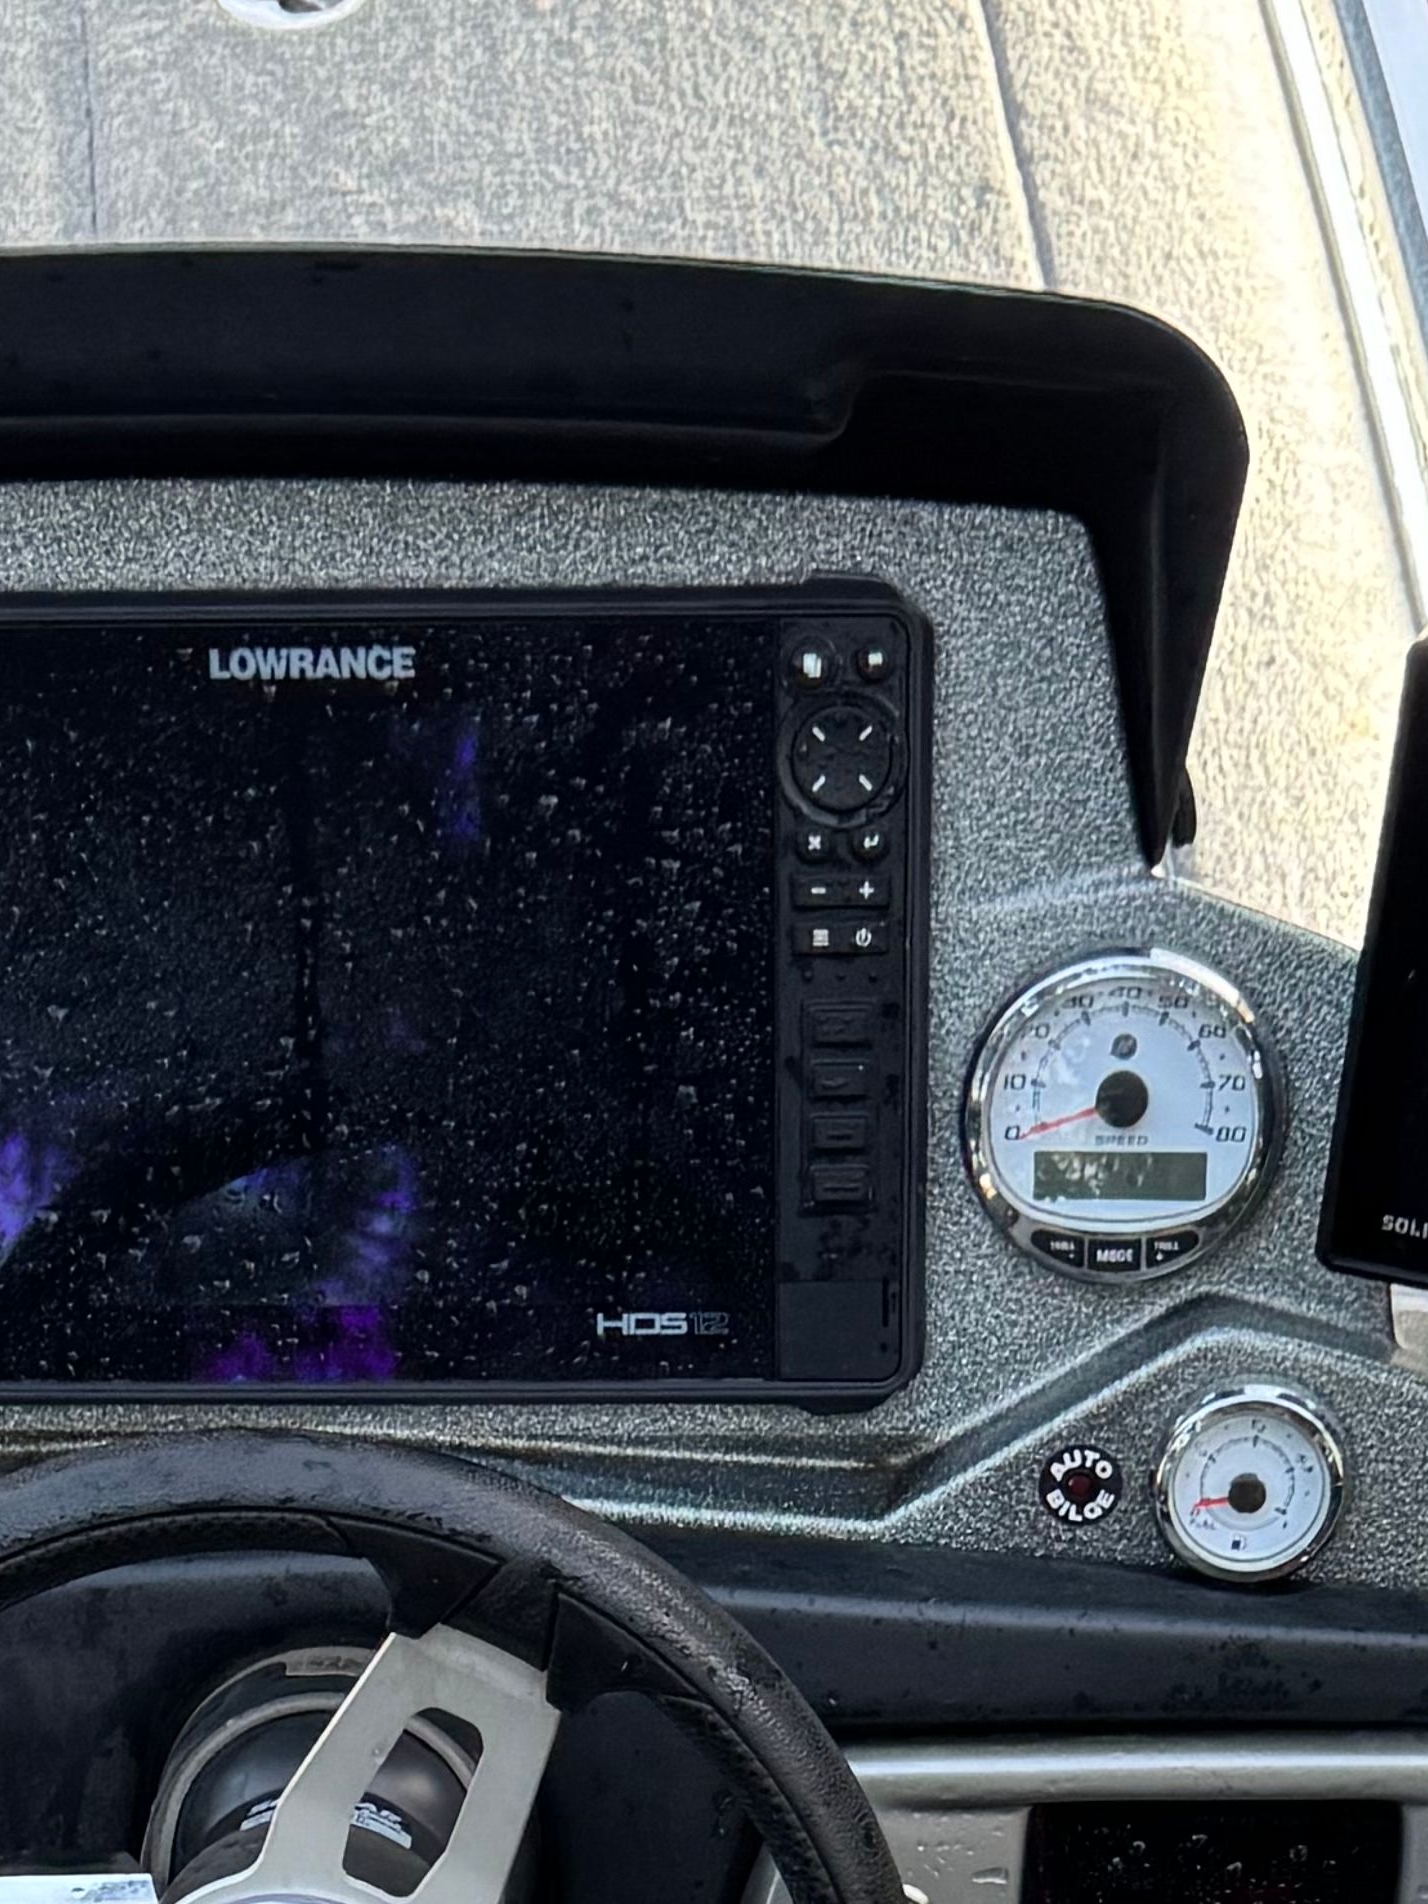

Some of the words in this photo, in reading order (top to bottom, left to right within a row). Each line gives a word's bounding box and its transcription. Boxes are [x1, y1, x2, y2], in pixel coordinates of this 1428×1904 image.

[208, 645, 416, 681] LOWRANCE
[1198, 1024, 1227, 1039] 60
[1003, 1073, 1027, 1091] 10
[1218, 1075, 1246, 1091] 70
[1004, 1125, 1021, 1141] 0
[1095, 1135, 1148, 1146] SPEED
[596, 1312, 688, 1336] HDS
[1049, 1449, 1113, 1482] AUTO
[1045, 1488, 1115, 1522] BILGE
